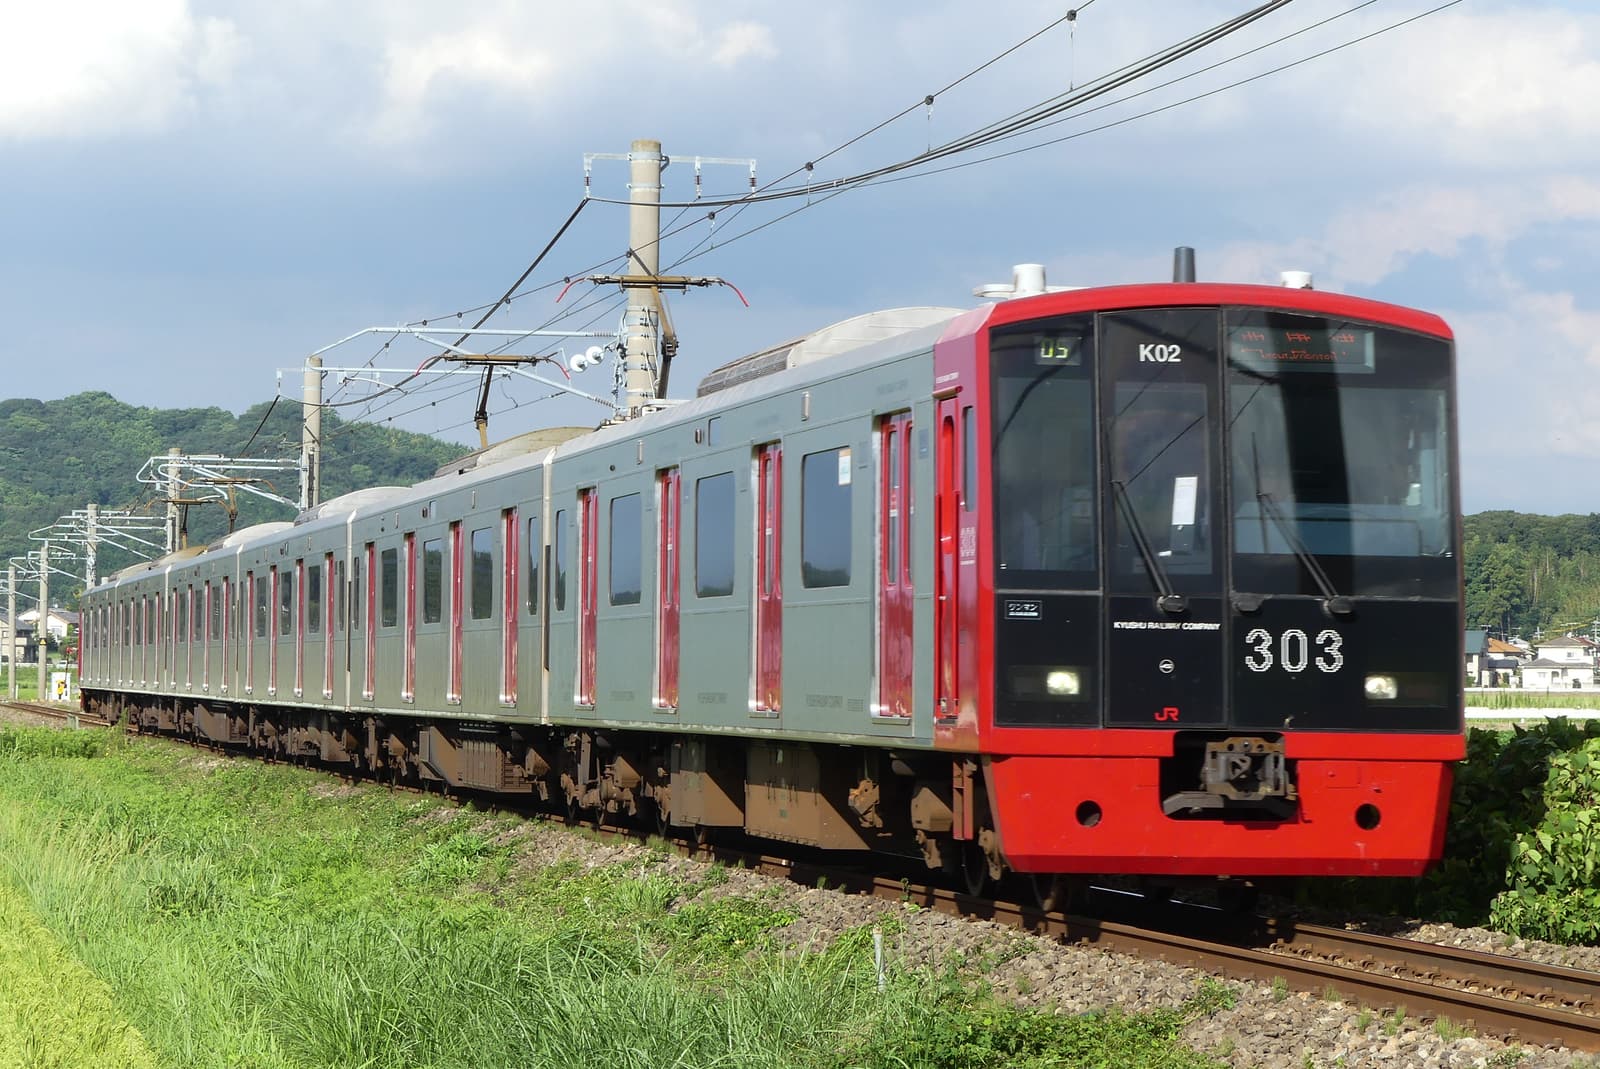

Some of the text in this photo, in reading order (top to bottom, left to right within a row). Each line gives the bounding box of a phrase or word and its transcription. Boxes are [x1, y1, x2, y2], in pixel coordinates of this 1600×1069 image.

[1139, 343, 1182, 362] K02
[1245, 628, 1344, 673] 303
[1154, 706, 1179, 721] JR
